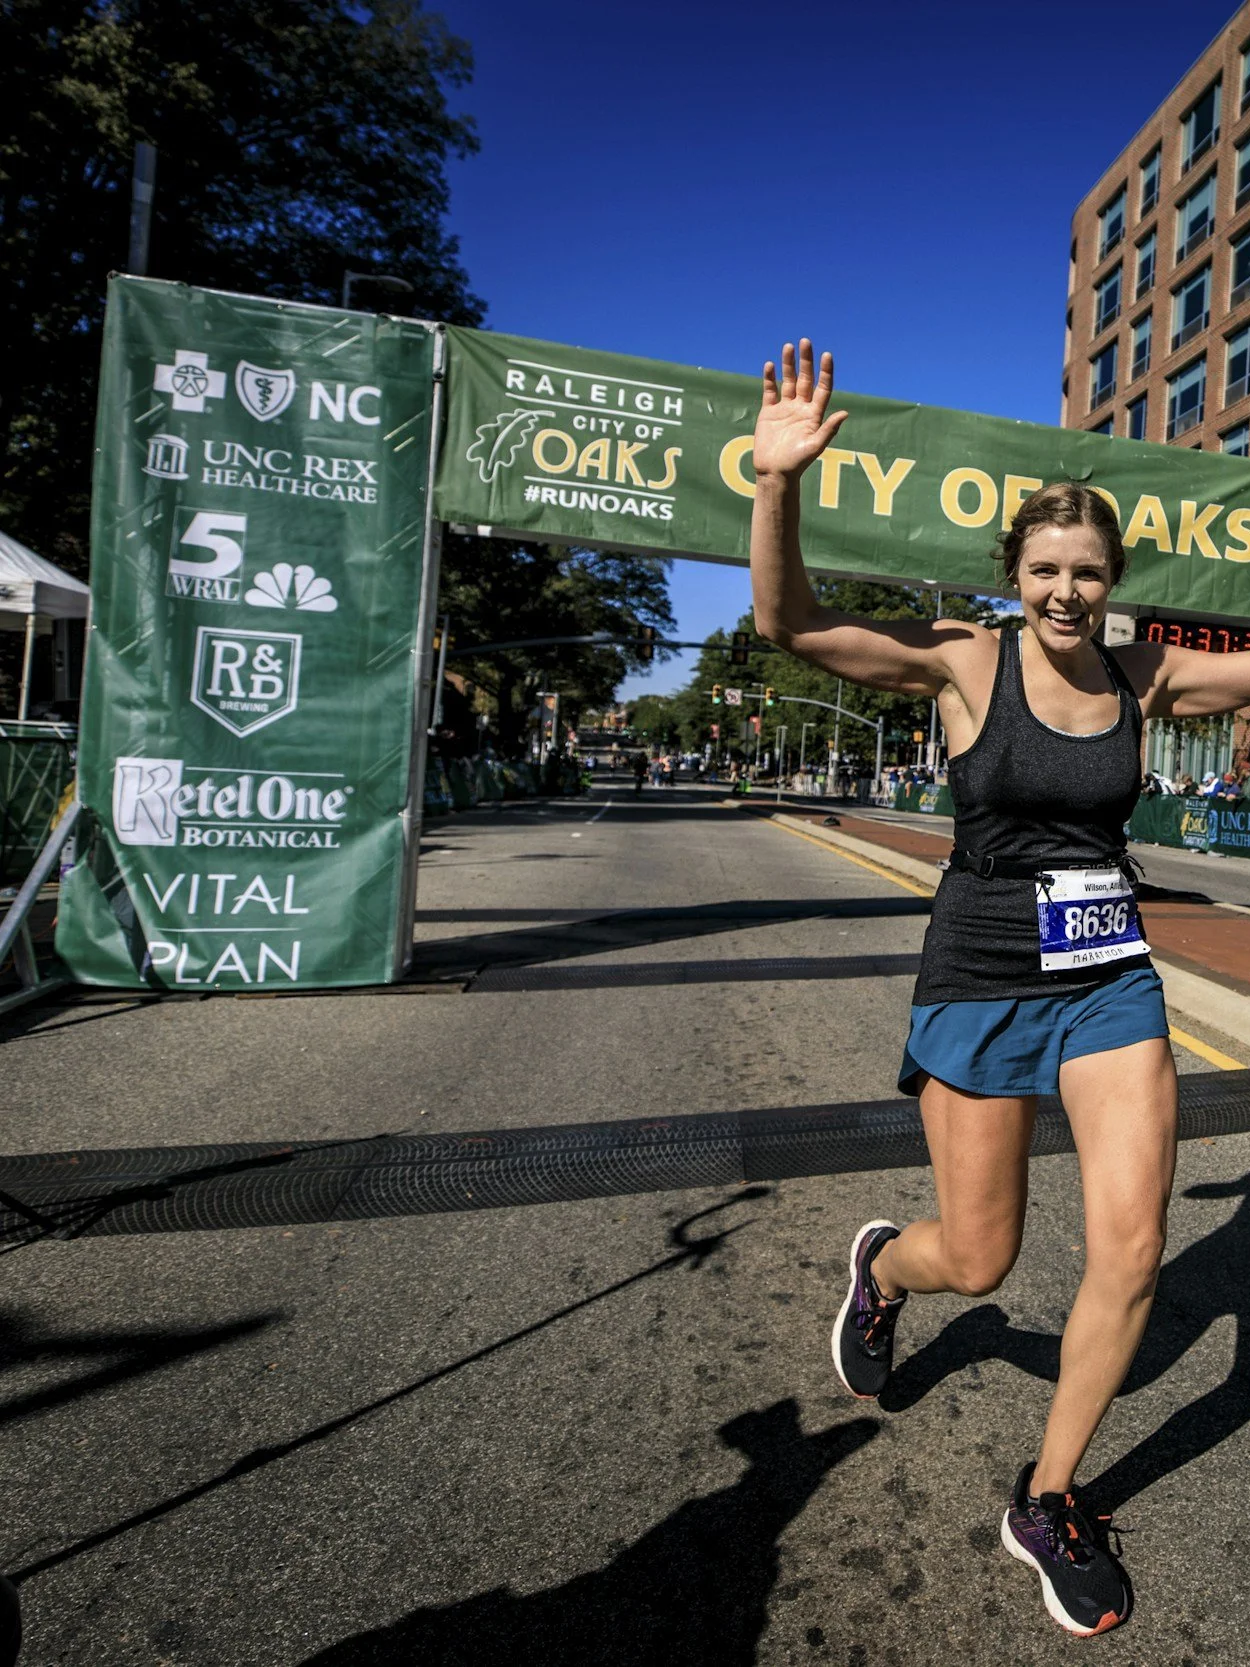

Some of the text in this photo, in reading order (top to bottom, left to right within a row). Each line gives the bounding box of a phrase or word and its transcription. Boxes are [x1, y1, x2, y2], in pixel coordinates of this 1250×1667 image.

[309, 381, 382, 426] NC
[506, 369, 683, 417] RALEIGH
[572, 414, 664, 441] CITY OF
[202, 440, 378, 485] UNC REX
[532, 428, 683, 490] OAKS
[719, 435, 916, 516] CTY
[202, 468, 378, 504] HEALTHCARE
[523, 484, 674, 521] #RUNOAKS
[169, 511, 247, 579] 5
[170, 574, 241, 602] WRAL
[219, 700, 269, 713] BREWING
[180, 827, 341, 849] BOTANICAL
[1221, 811, 1246, 831] UNC
[143, 873, 309, 914] VITAL
[1084, 883, 1109, 892] Wilson,
[1064, 902, 1129, 941] 8636
[139, 941, 300, 983] PLAN
[1073, 948, 1125, 964] MARATHON
